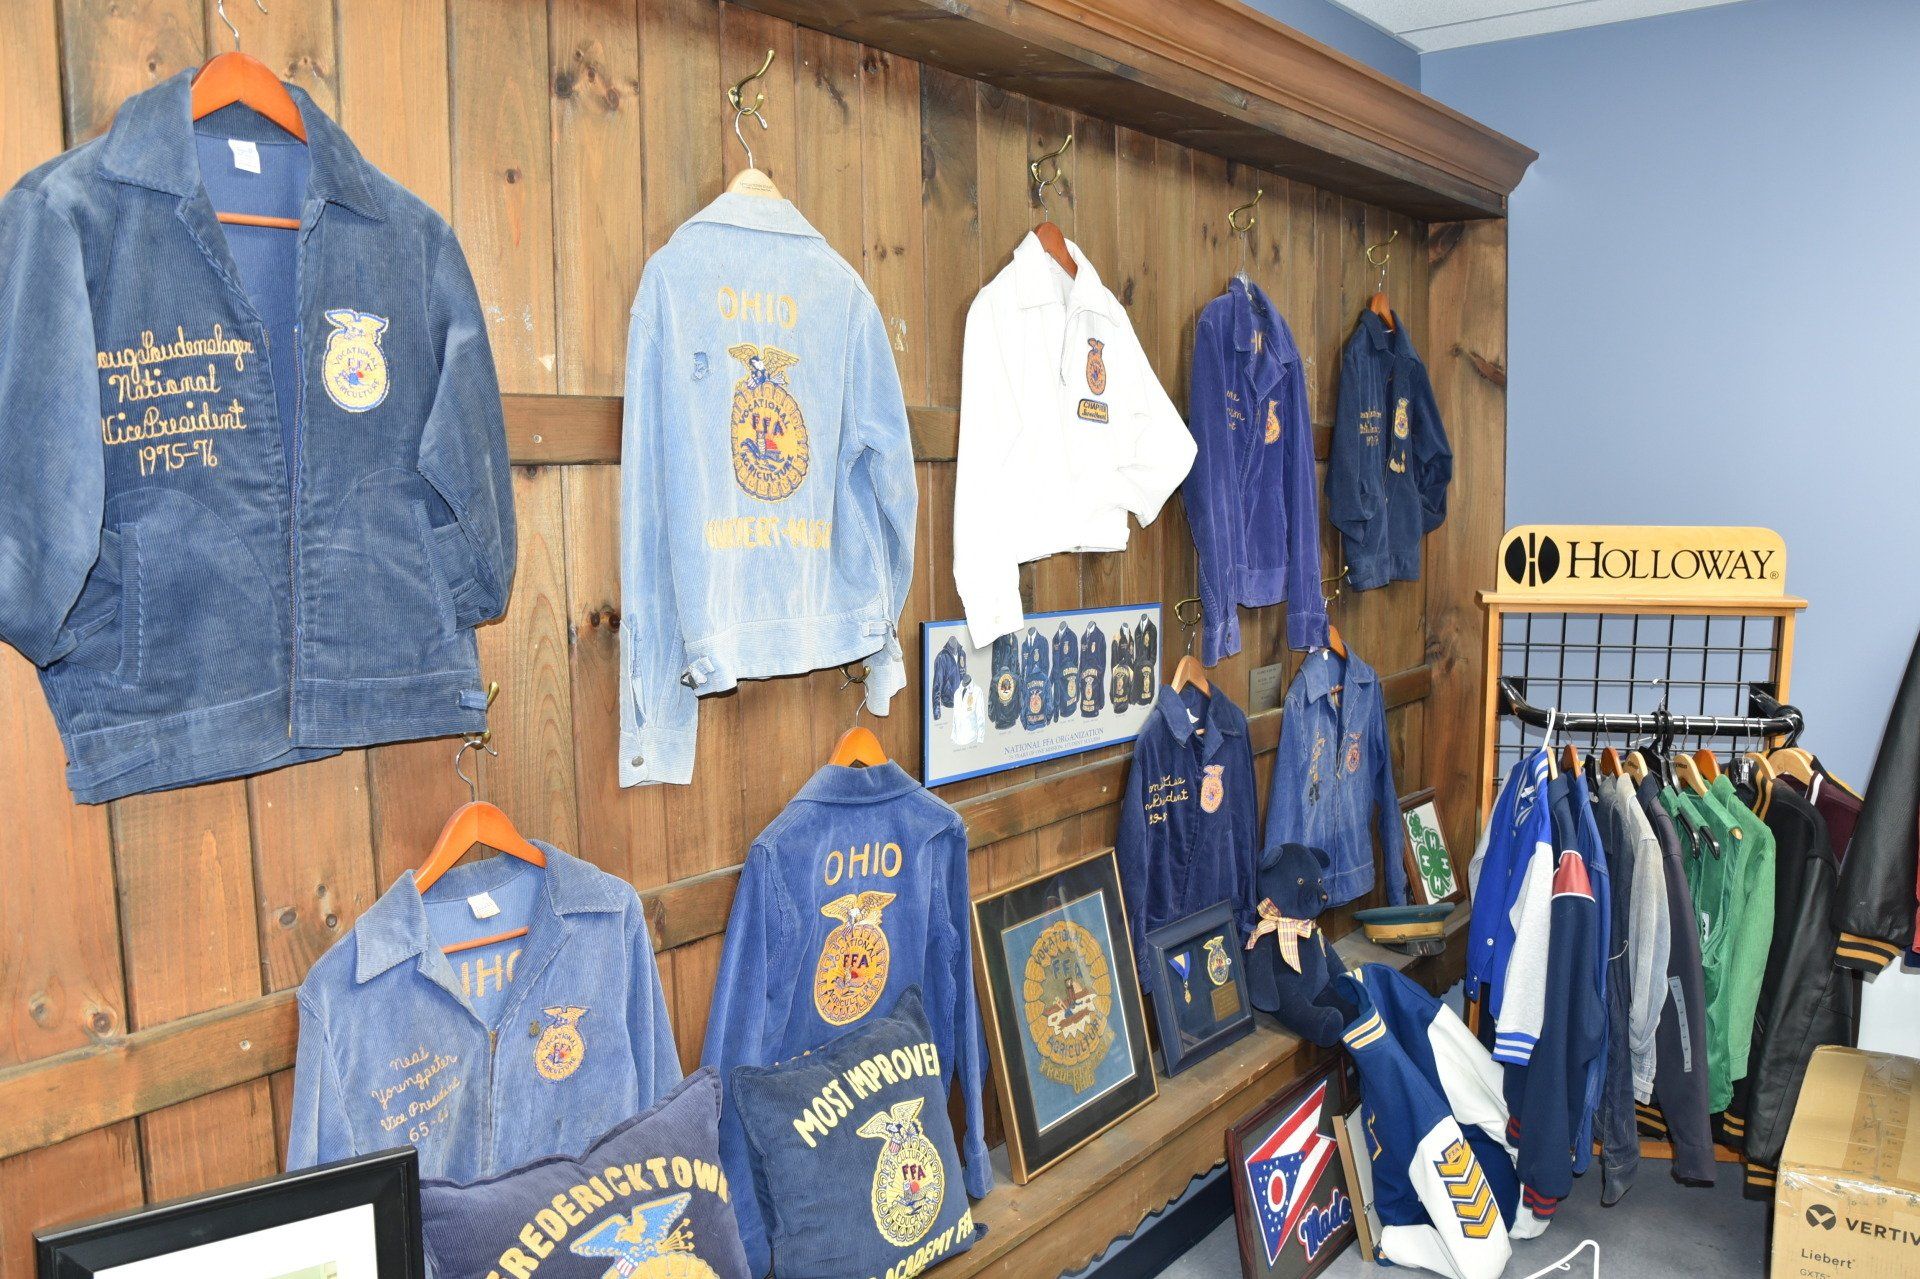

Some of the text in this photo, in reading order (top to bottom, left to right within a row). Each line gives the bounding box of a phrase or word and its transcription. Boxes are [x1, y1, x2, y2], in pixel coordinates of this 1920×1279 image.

[717, 286, 799, 330] OHIO
[347, 357, 373, 372] FFA
[108, 363, 221, 403] National
[142, 398, 247, 438] President
[738, 398, 791, 429] VOCATIONAL
[751, 412, 784, 436] FFA
[139, 438, 218, 477] 1975-76
[740, 453, 794, 482] AGRICULTURE
[1566, 541, 1776, 580] HOLLOWAY
[1004, 739, 1041, 755] NATIONAL
[1055, 727, 1105, 744] ORGANIZATION
[824, 842, 902, 886] OHIO
[842, 954, 870, 969] FFA
[1052, 958, 1084, 981] FFA
[389, 1044, 430, 1071] Neal
[553, 1042, 572, 1054] FFA
[380, 1112, 408, 1132] Vice
[793, 1078, 855, 1149] MOST
[901, 1163, 926, 1181] FFA
[1845, 1217, 1920, 1247] VERTIV
